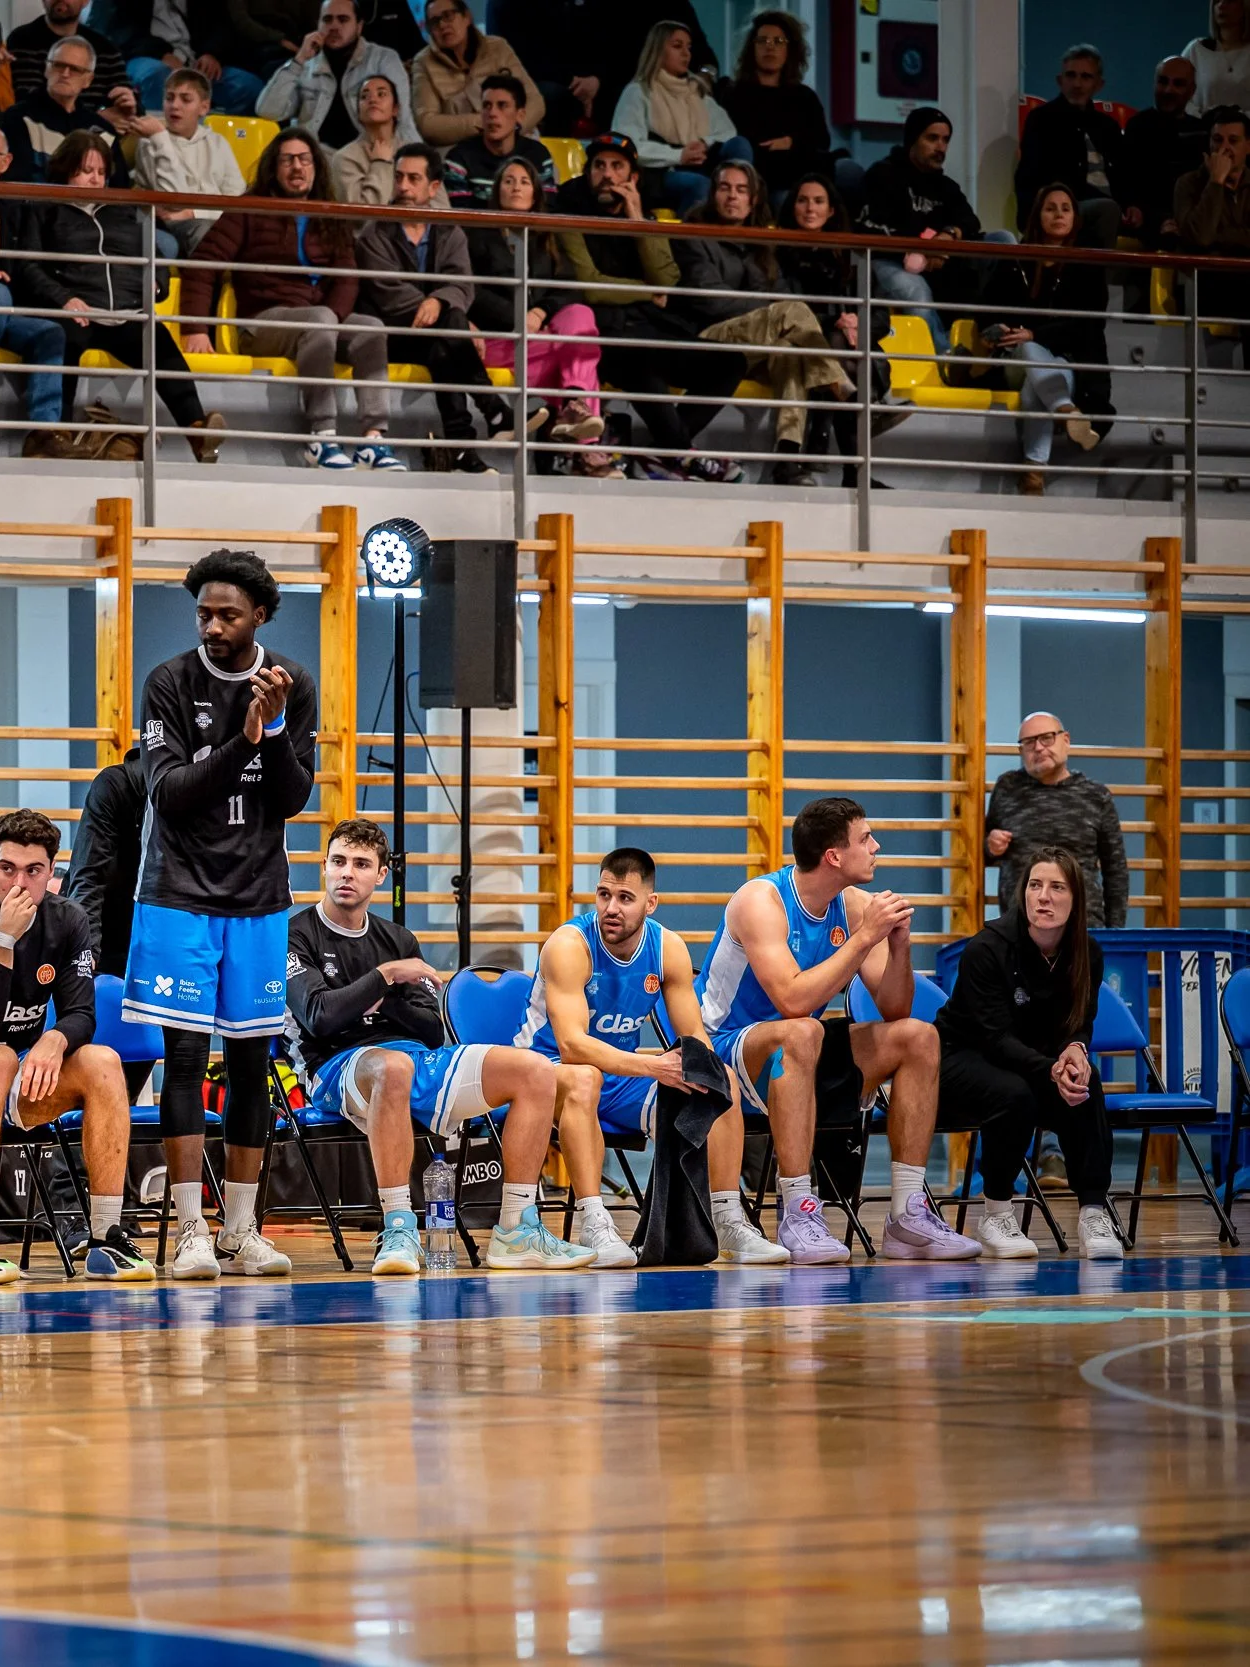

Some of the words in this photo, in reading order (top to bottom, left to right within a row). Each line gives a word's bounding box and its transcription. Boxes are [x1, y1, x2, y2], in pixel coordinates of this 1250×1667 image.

[240, 773, 256, 782] Ret
[228, 795, 245, 825] 11
[179, 978, 196, 988] Ibiza
[178, 985, 202, 996] Feeling
[177, 992, 200, 1004] Hotels
[2, 1000, 48, 1023] lass
[7, 1023, 27, 1033] Rent
[595, 1013, 646, 1034] Clas
[14, 1169, 27, 1197] 17
[444, 1205, 455, 1213] Fon
